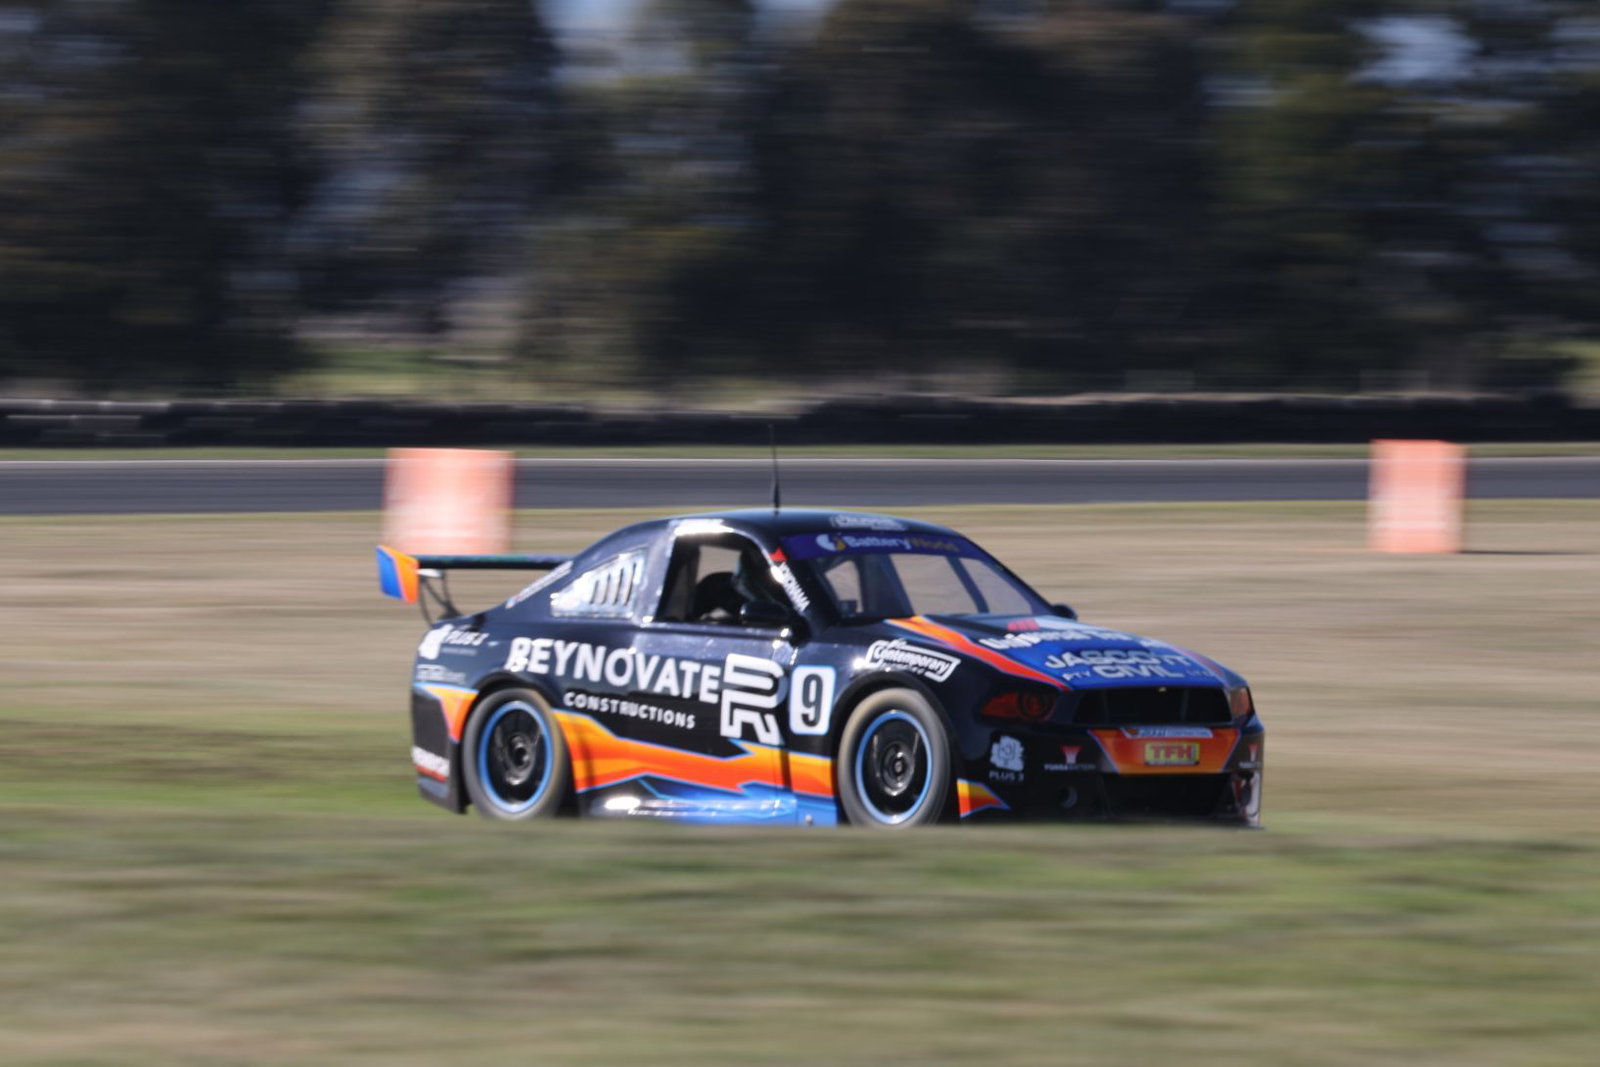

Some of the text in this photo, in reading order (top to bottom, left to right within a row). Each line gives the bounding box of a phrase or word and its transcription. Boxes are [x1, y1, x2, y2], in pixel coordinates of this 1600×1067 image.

[843, 535, 912, 550] Battery
[873, 646, 949, 675] Contemporary
[562, 692, 696, 729] CONSTRUCTIONS
[801, 673, 824, 727] 9
[989, 770, 1016, 781] PLUS
